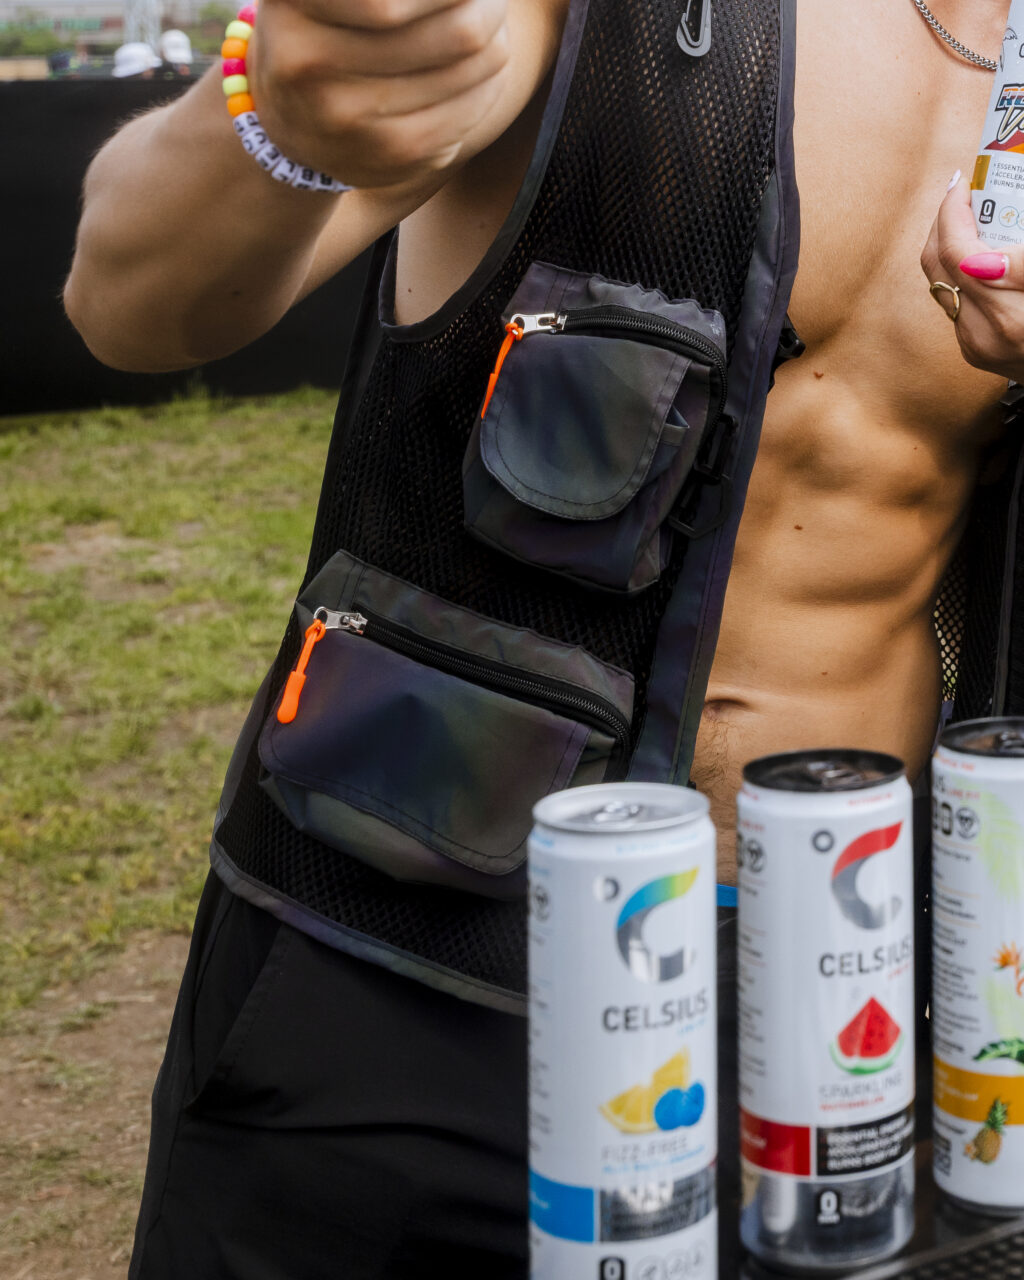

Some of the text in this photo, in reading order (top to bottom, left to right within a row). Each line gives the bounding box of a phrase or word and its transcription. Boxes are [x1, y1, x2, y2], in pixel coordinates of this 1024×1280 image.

[993, 180, 1014, 189] BURNS
[818, 933, 912, 978] CELSIUS
[602, 986, 708, 1033] CELSIUS
